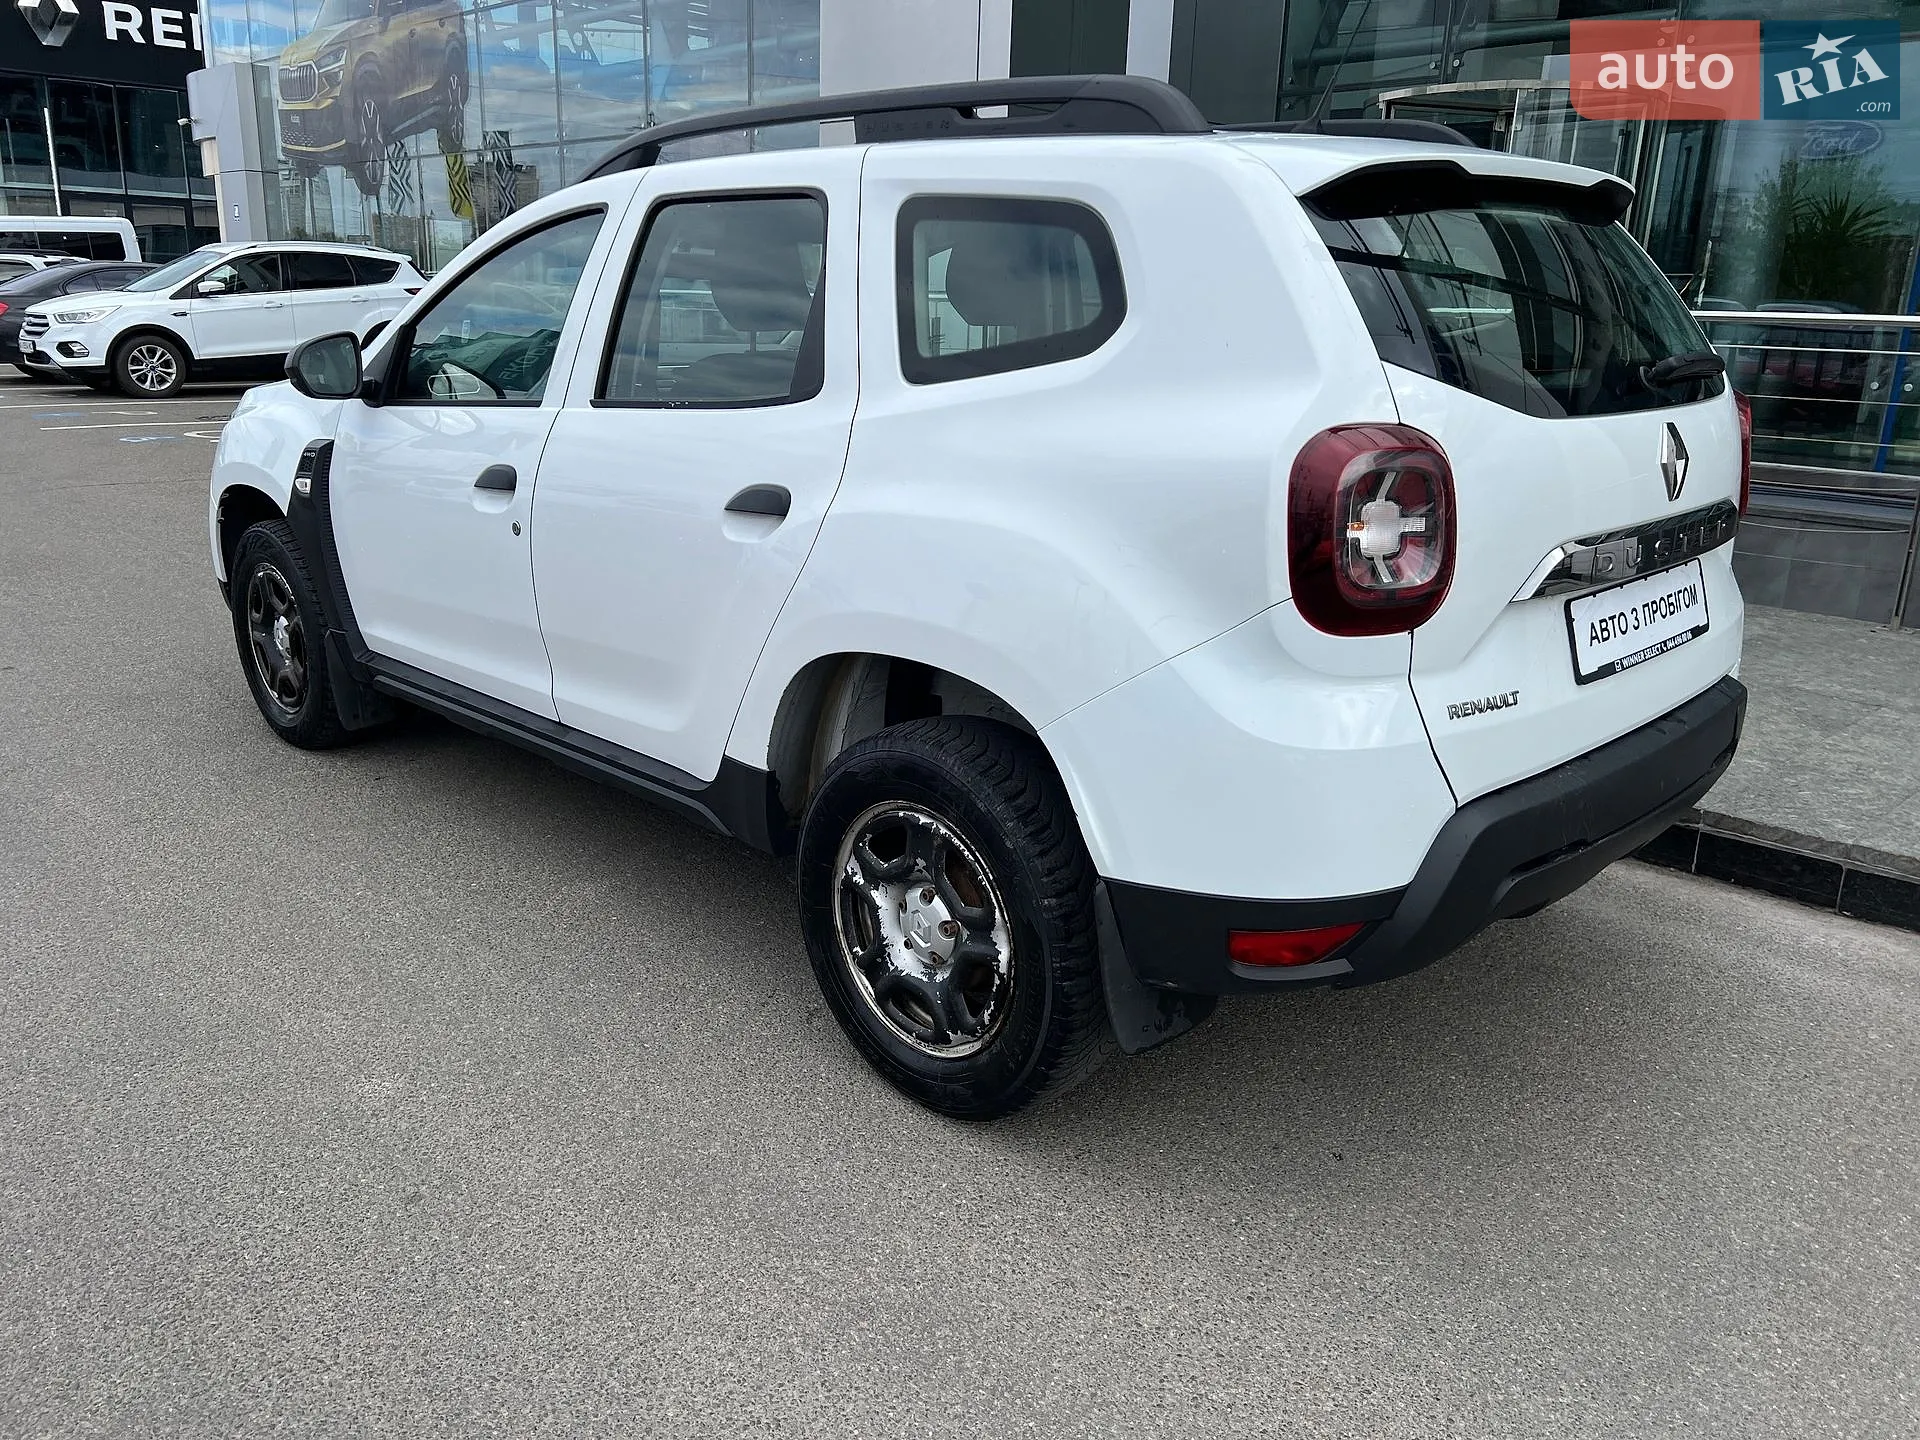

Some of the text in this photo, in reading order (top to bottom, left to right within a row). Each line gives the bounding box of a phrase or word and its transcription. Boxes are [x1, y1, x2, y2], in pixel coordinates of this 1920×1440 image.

[1589, 612, 1629, 647] АВТО
[1642, 583, 1698, 627] ПРОБІГОМ
[1621, 651, 1645, 669] WINNER
[1644, 643, 1662, 660] SELECT
[1446, 689, 1520, 720] RENAULT
